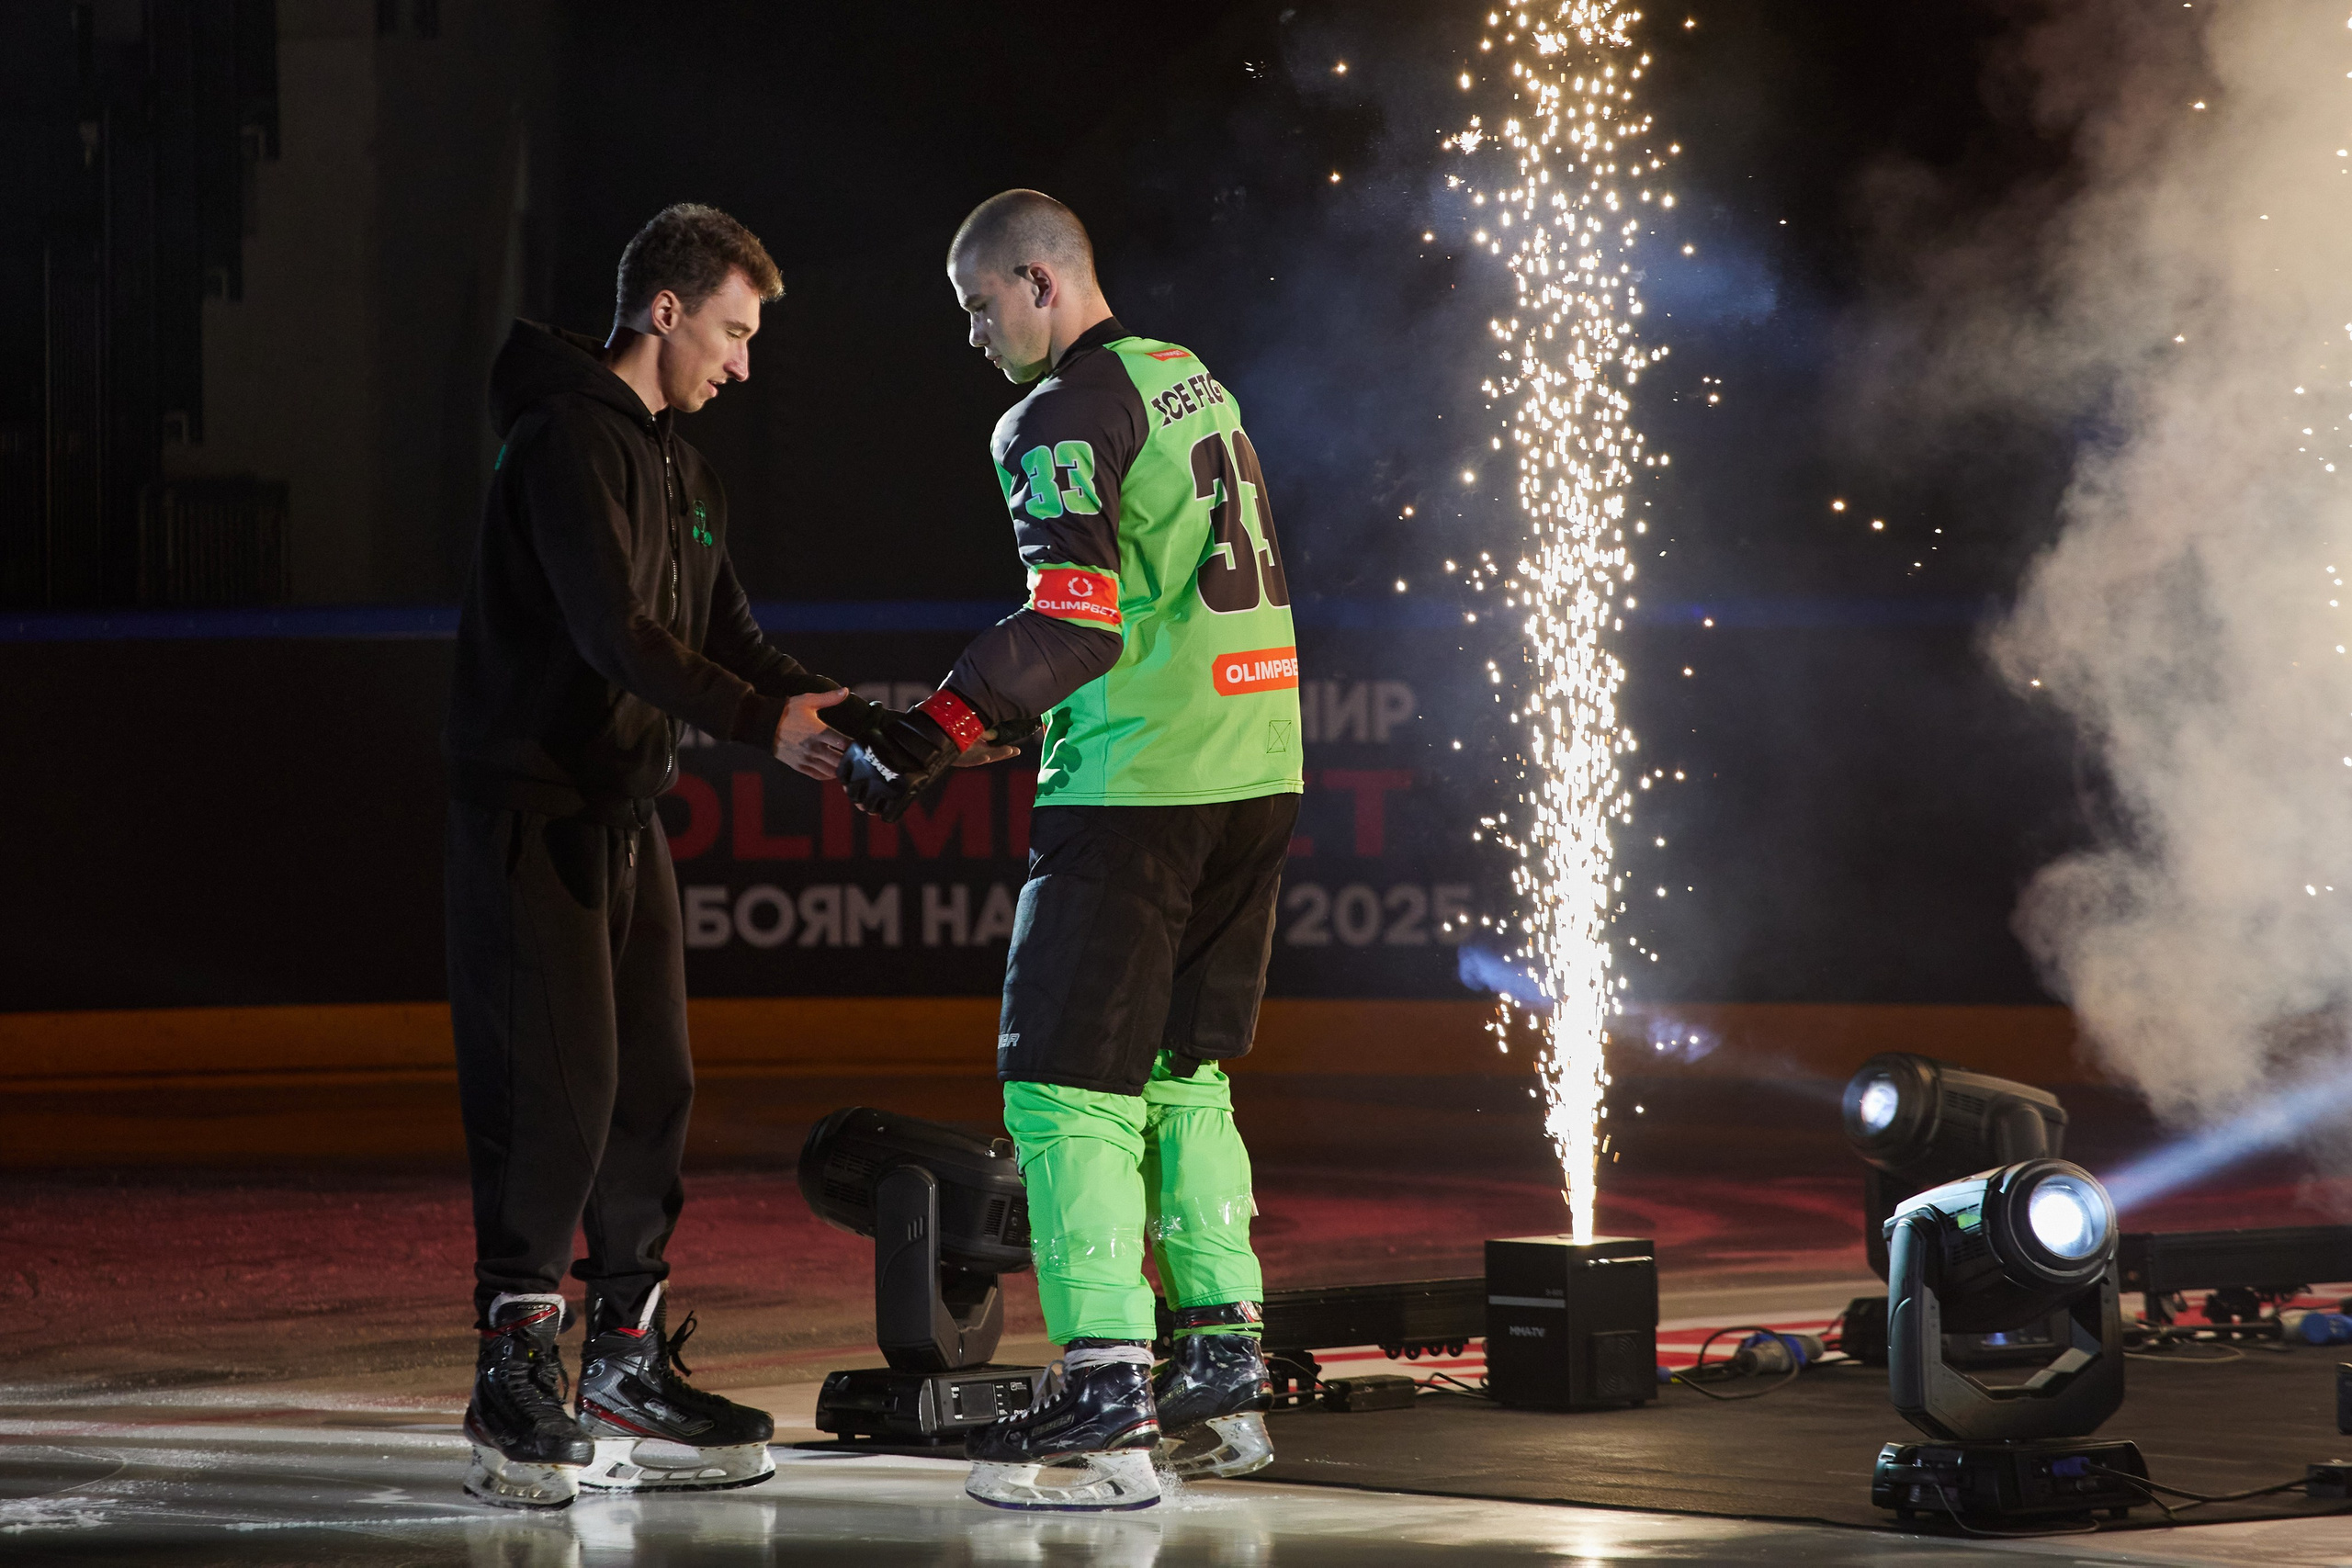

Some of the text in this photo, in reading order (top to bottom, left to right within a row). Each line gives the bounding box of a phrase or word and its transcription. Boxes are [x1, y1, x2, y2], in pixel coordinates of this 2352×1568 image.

[1150, 382, 1198, 427] ICE
[1020, 439, 1102, 521] 33
[1036, 599, 1119, 618] OLIMPBET
[683, 882, 904, 950] БОЯМ
[1285, 883, 1473, 948] 2025
